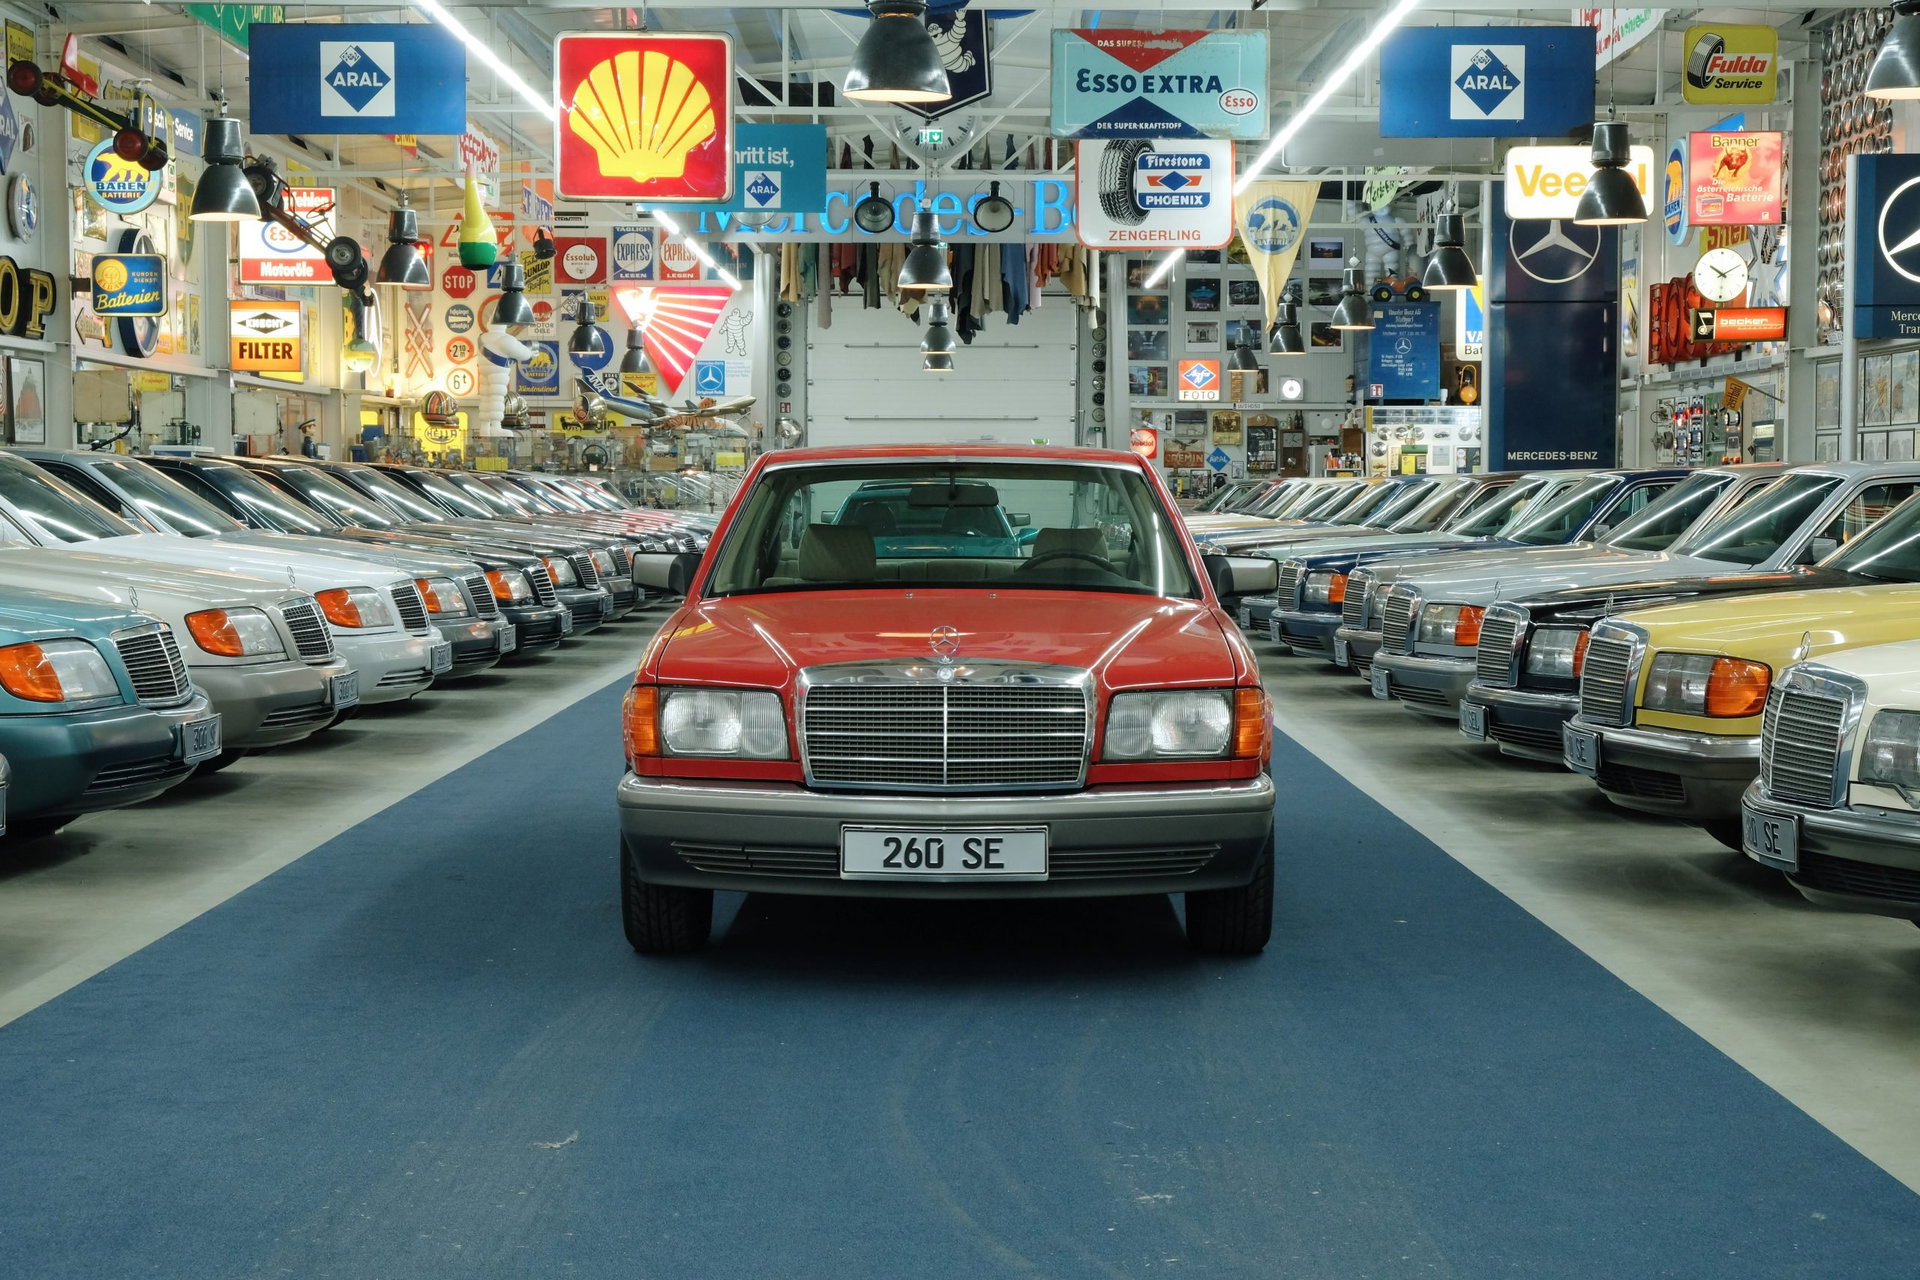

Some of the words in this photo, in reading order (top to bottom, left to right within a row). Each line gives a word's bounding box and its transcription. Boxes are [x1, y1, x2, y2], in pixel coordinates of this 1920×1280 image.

[1097, 39, 1114, 47] DAS
[1707, 55, 1767, 73] Fulda
[332, 71, 383, 87] ARAL
[1142, 75, 1223, 94] EXTRA
[1463, 75, 1513, 90] ARAL
[1714, 77, 1763, 89] Service
[174, 117, 194, 142] Service
[1096, 122, 1112, 130] DER
[1114, 122, 1182, 130] SUPER-KRAFTSTOFF
[1712, 135, 1759, 147] Banner
[767, 147, 795, 168] ist,
[1145, 154, 1203, 168] Firestone
[1514, 163, 1647, 197] Veel
[750, 185, 776, 194] ARAL
[1696, 185, 1763, 193] österreichische
[1145, 195, 1203, 205] PHOENIX
[1726, 193, 1774, 203] Batterie
[269, 226, 303, 241] Ess
[1108, 230, 1201, 241] ZENGERLING
[565, 253, 596, 261] Essolub
[616, 243, 650, 261] EXPRESS
[663, 243, 697, 261] EXPRESS
[260, 261, 314, 277] Motoröle
[444, 275, 474, 289] STOP
[95, 289, 160, 310] Batterien
[245, 318, 285, 329] KNECHT
[1720, 317, 1768, 325] becker
[238, 342, 293, 360] FILTER
[585, 373, 606, 393] ANA
[1183, 391, 1215, 400] FOTO
[1507, 451, 1598, 460] MERCEDES-BENZ
[1763, 820, 1782, 855] SE
[883, 837, 944, 869] 260
[961, 837, 1004, 869] SE
